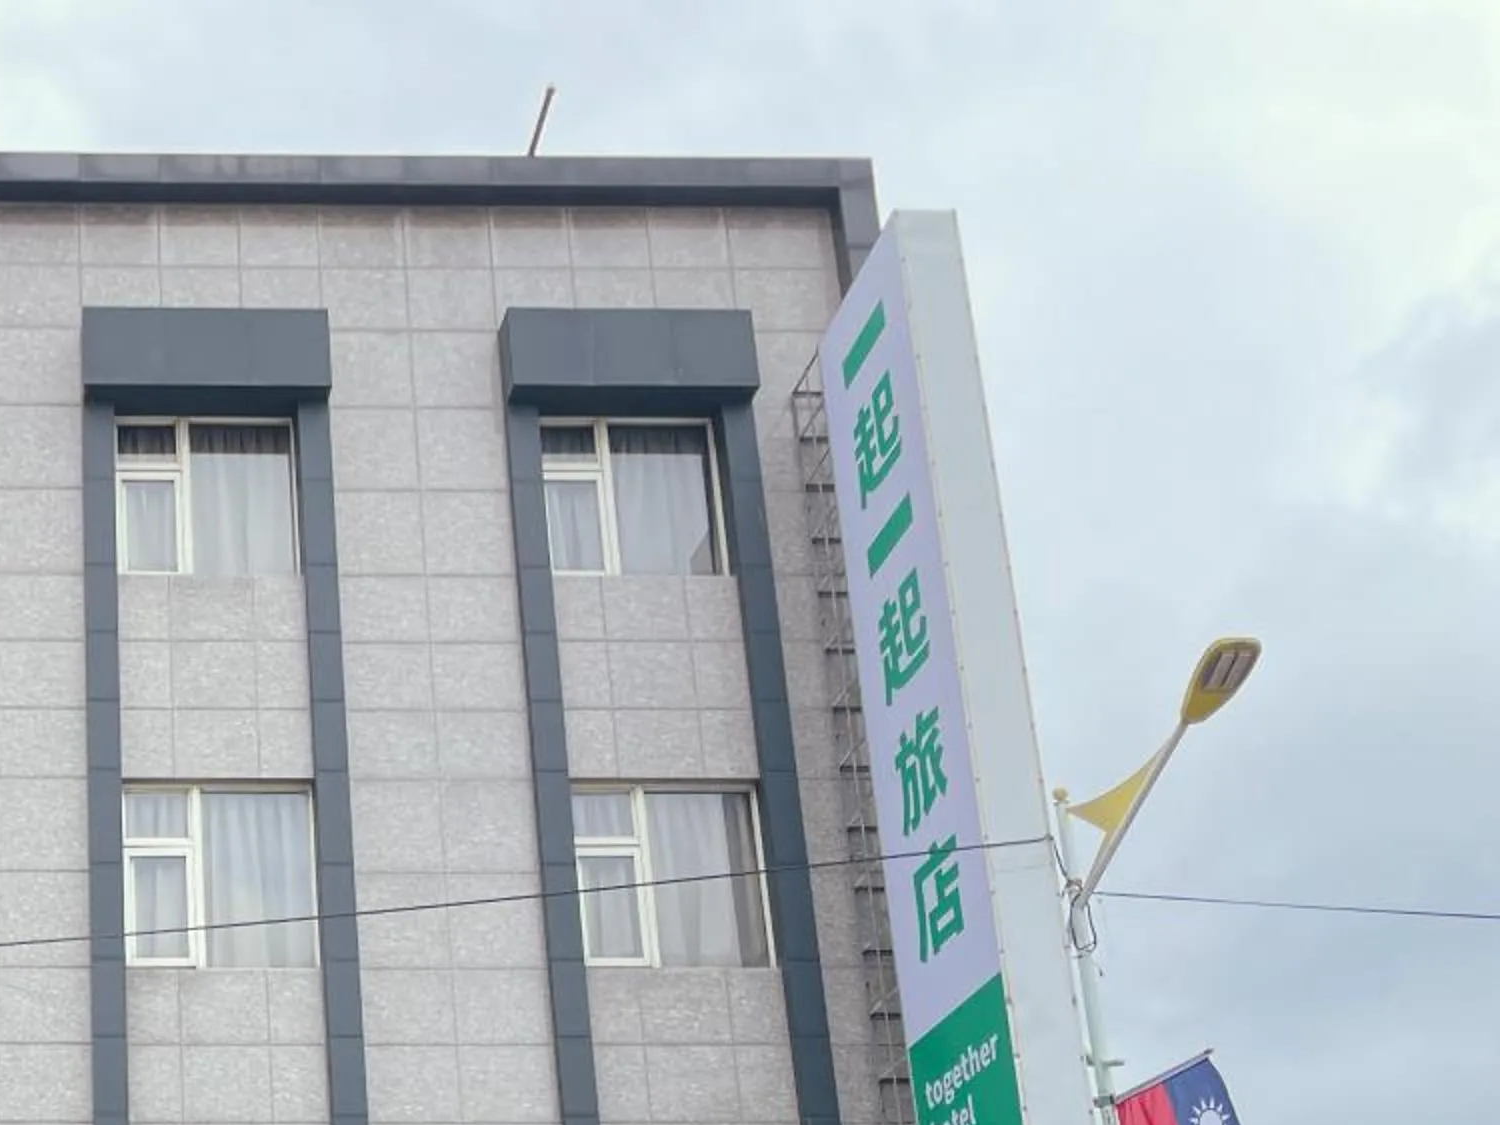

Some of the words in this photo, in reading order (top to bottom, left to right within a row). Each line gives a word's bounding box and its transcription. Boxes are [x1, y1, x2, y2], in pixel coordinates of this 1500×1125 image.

[842, 300, 965, 962] 一起一起旅店
[925, 1034, 998, 1110] together
